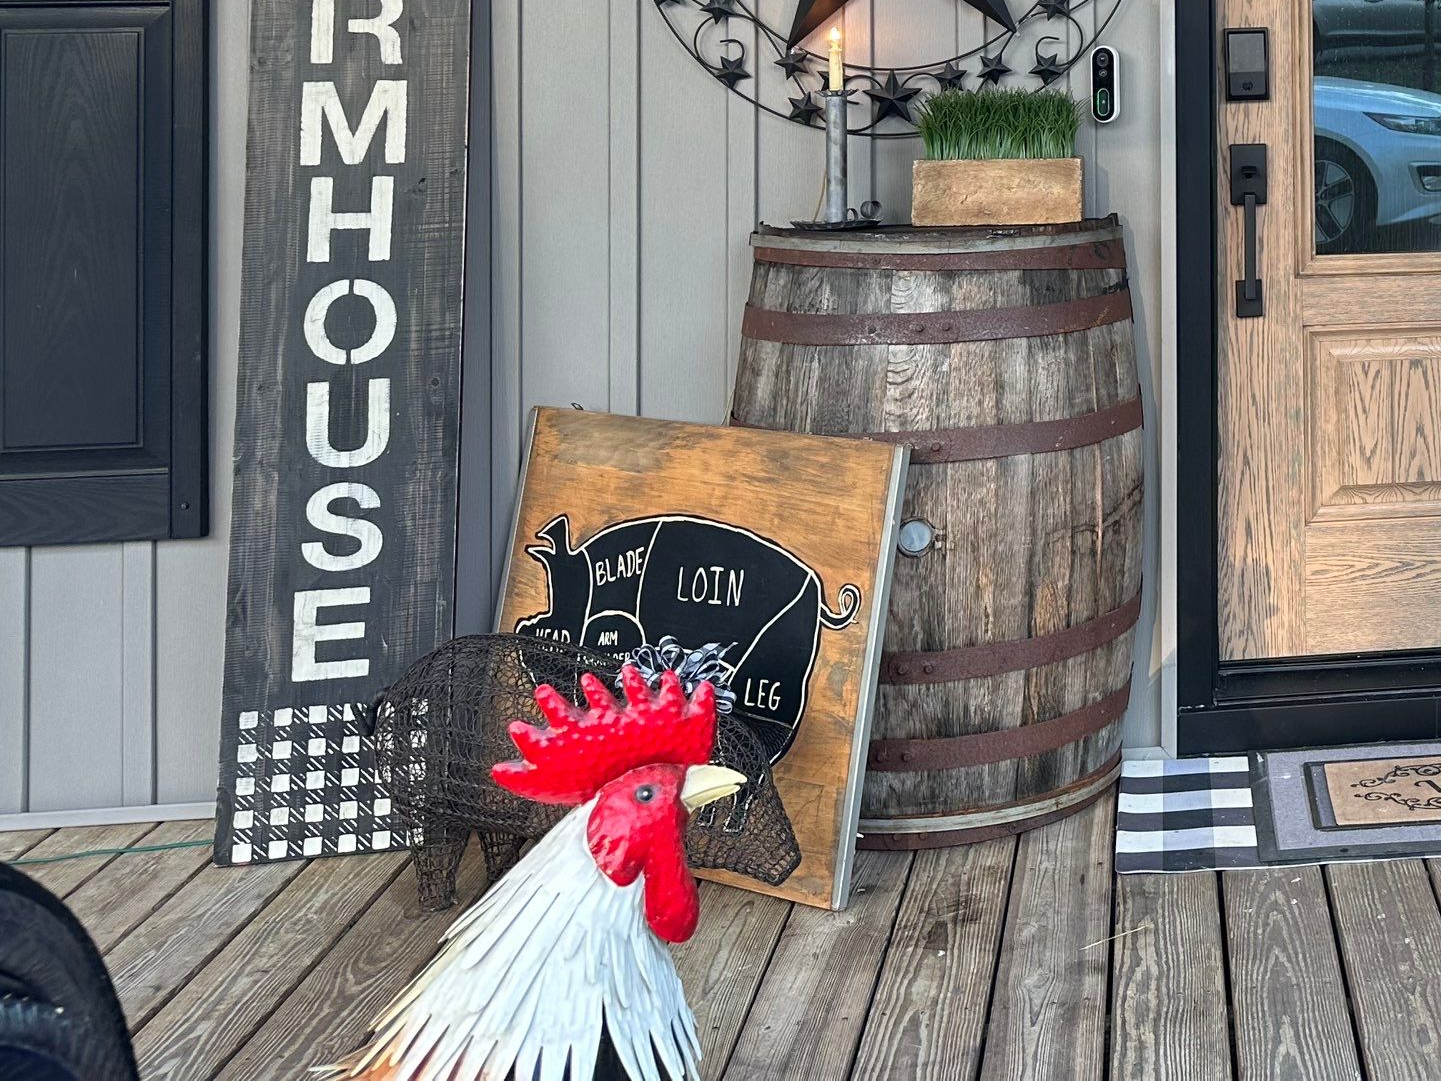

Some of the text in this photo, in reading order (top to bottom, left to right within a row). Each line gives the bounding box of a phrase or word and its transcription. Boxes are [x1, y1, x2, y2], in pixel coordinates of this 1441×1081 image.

[595, 546, 645, 586] BLADE
[677, 566, 745, 606] LOIN
[597, 630, 619, 646] ARM
[744, 677, 781, 711] LEG
